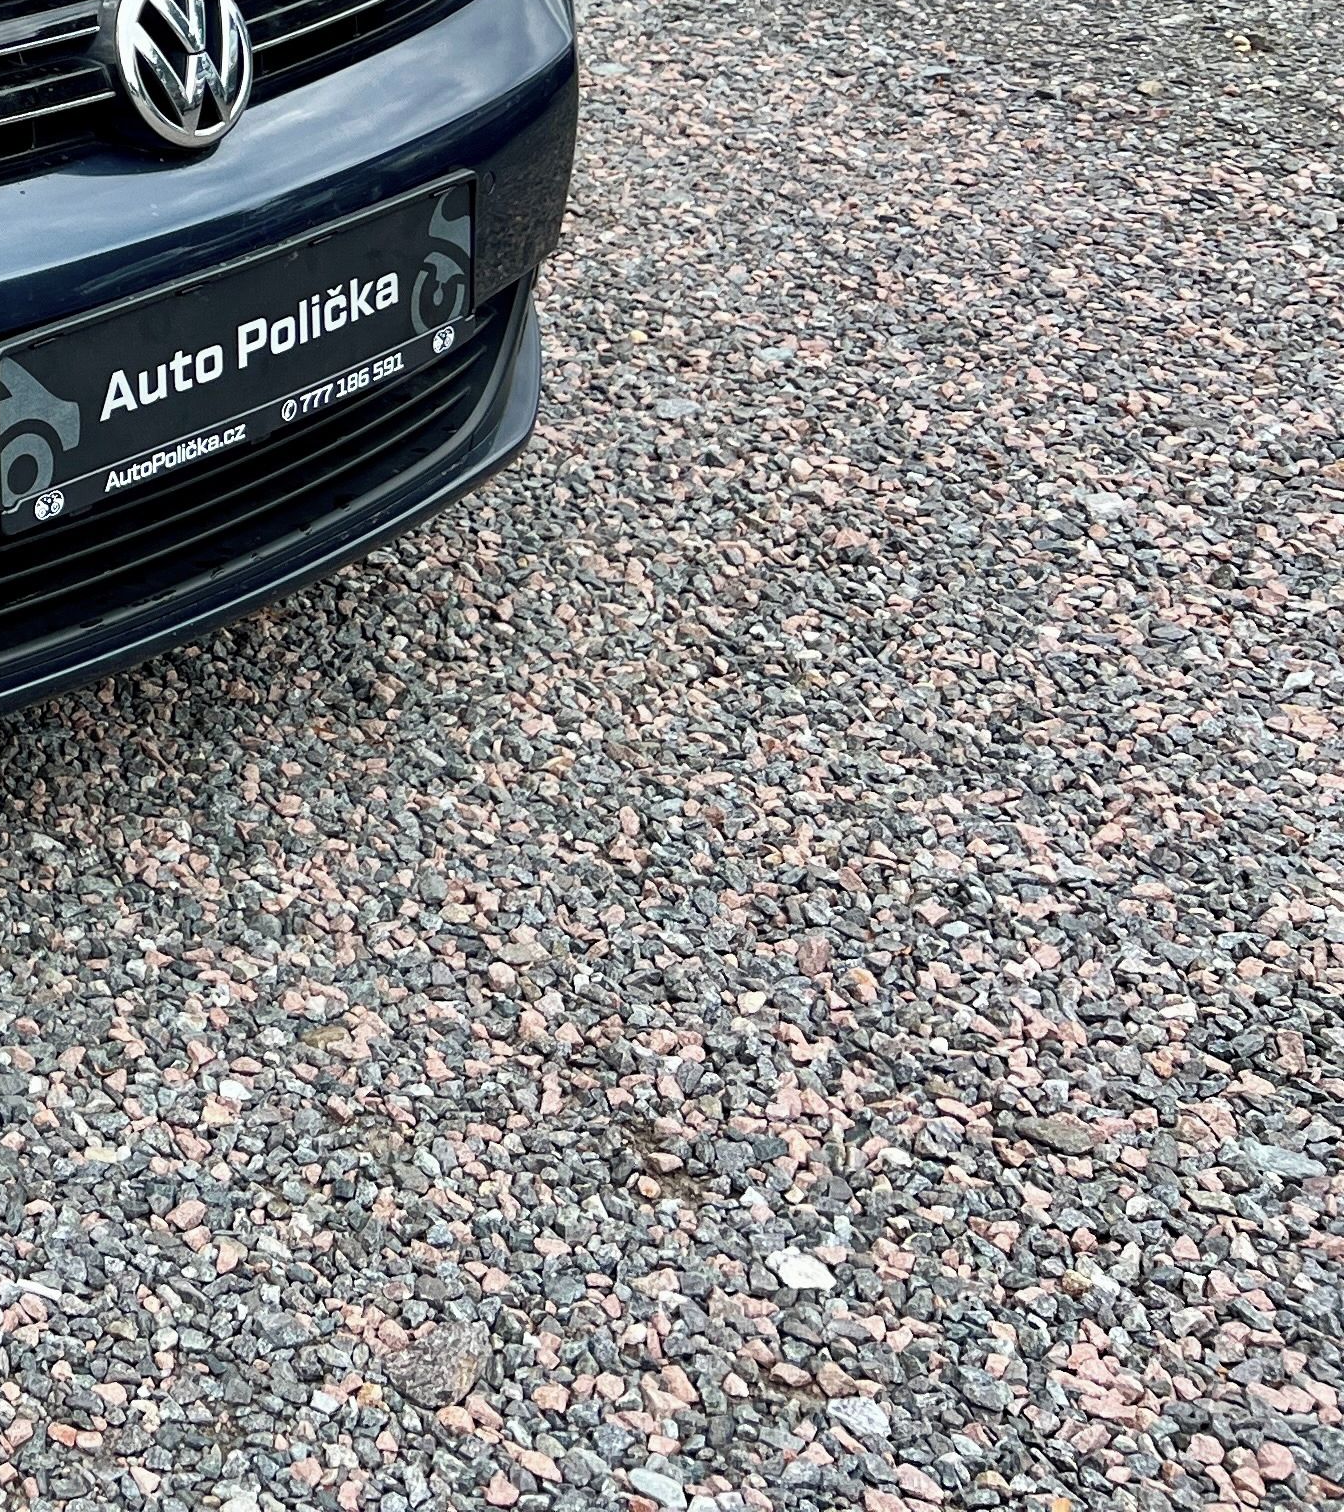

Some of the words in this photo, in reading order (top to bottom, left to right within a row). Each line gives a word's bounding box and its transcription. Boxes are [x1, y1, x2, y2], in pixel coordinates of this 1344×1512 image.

[99, 344, 223, 422] Auto
[237, 272, 399, 369] Polička
[301, 383, 334, 414] 777
[335, 367, 370, 399] 186
[372, 352, 404, 383] 591
[105, 423, 247, 493] AutoPolička.cz
